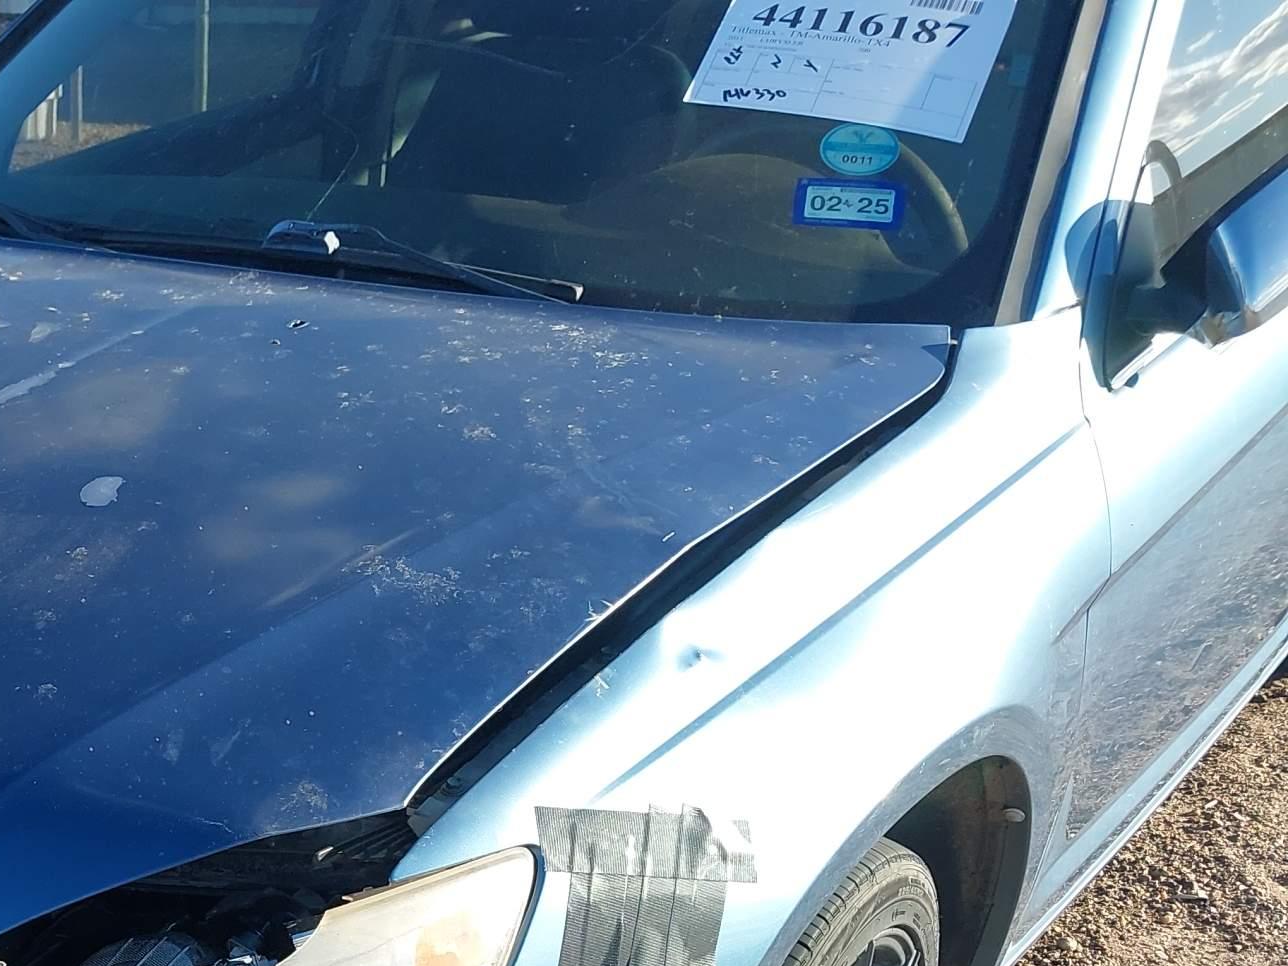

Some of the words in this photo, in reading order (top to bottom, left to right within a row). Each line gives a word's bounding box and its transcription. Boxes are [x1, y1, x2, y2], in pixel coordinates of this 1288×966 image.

[752, 3, 971, 48] 44116187
[841, 154, 873, 165] 0011
[810, 195, 842, 212] 02
[856, 197, 890, 215] 25
